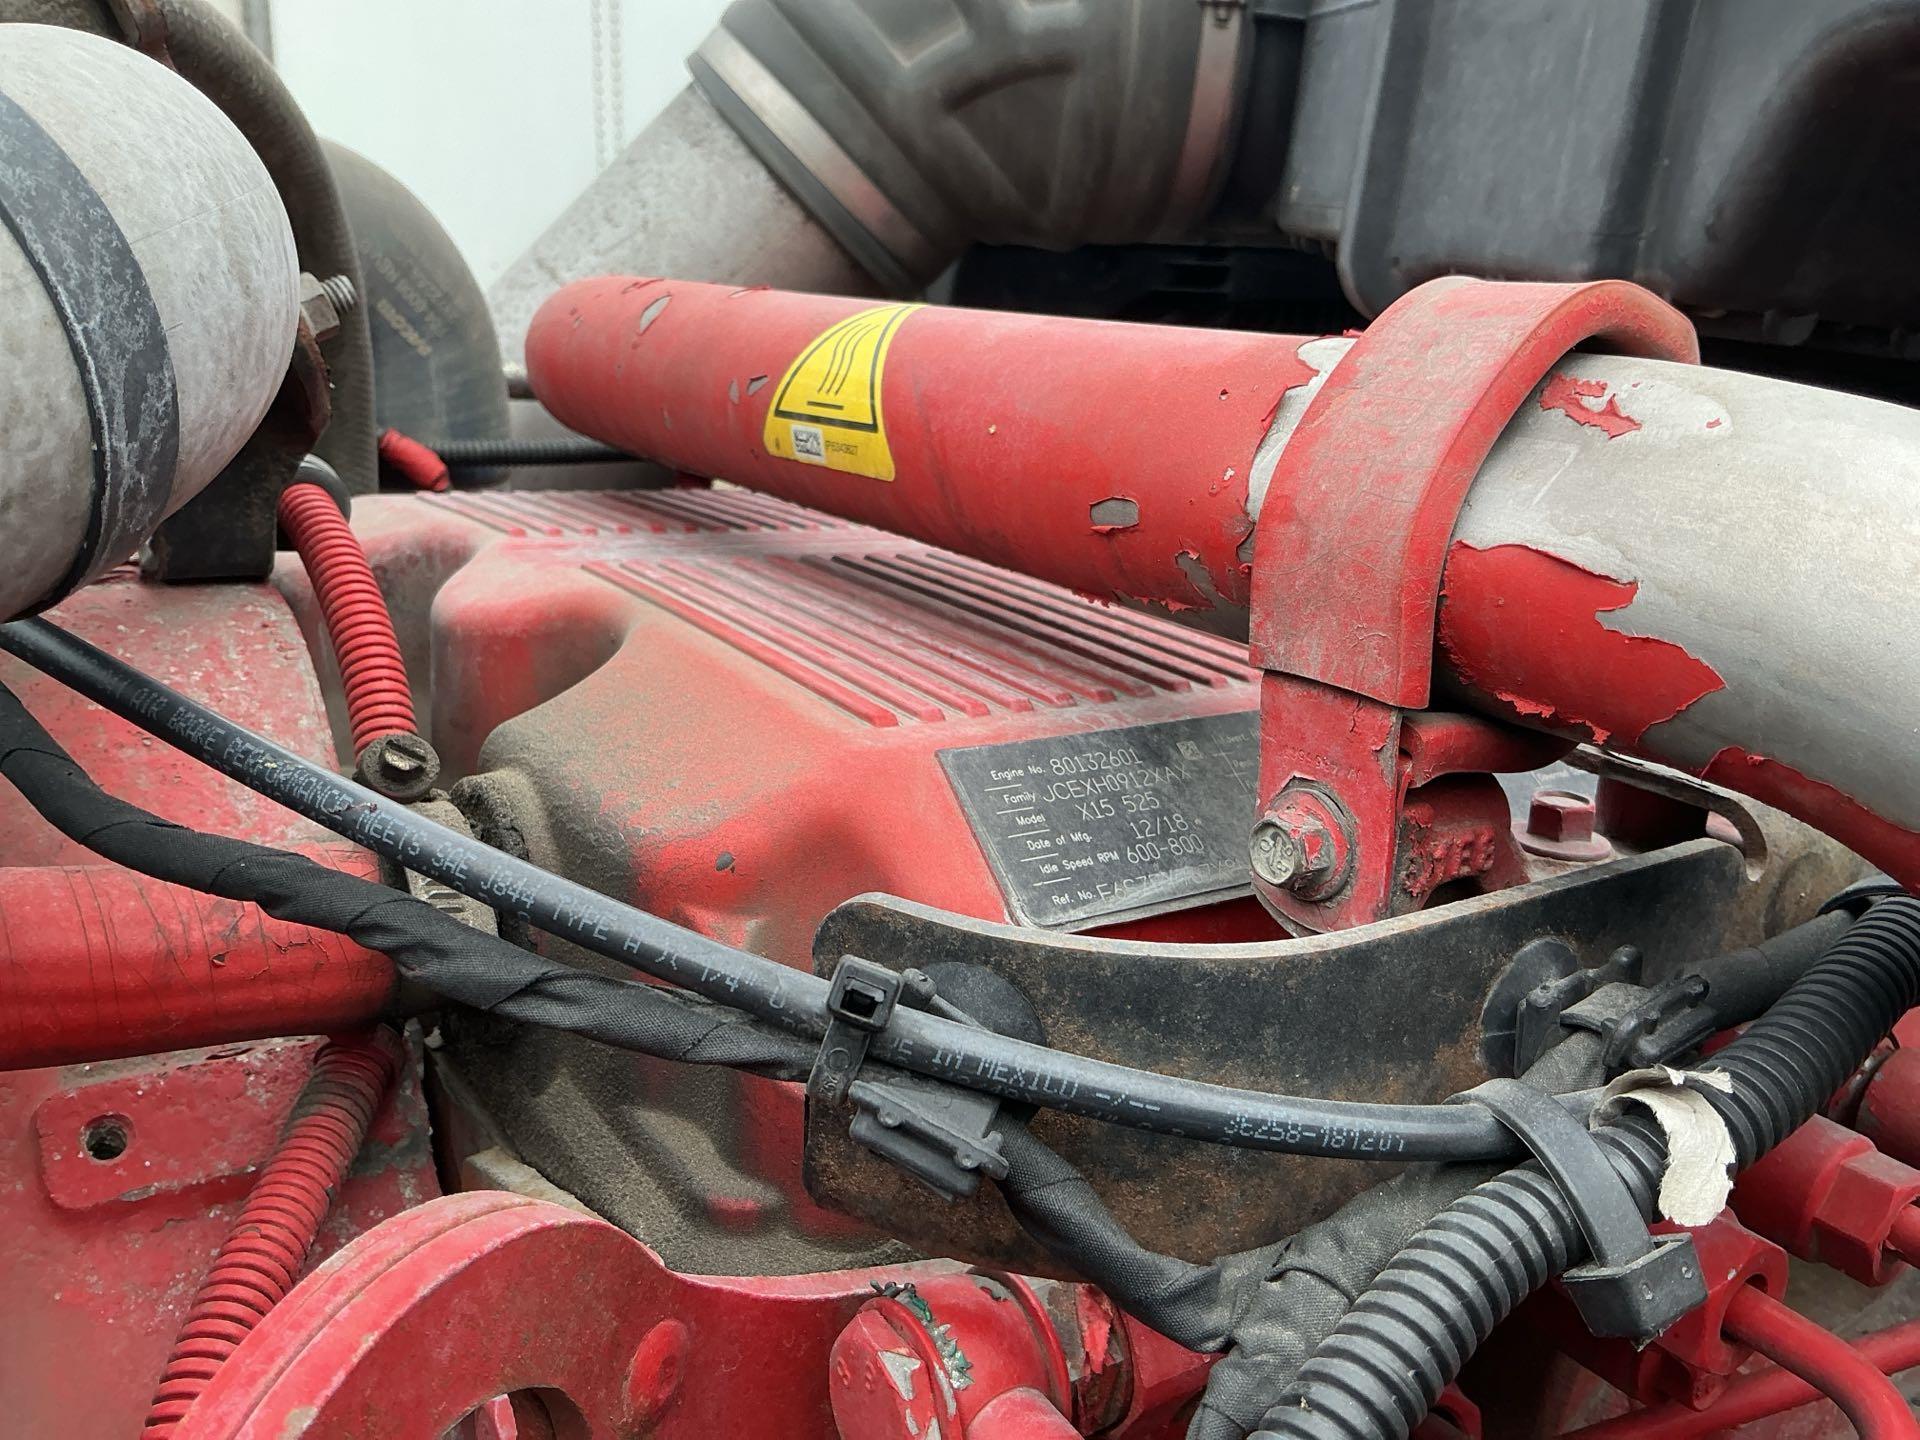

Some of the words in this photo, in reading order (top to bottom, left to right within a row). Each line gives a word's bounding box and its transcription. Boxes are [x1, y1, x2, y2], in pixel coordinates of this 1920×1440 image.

[990, 768, 1024, 781] Engine
[1028, 765, 1046, 775] No.
[1049, 748, 1143, 776] 80132601
[1003, 791, 1036, 804] Family
[1043, 762, 1192, 802] JCEXH0912XAX
[1015, 813, 1046, 826] Model
[1075, 798, 1115, 820] X15
[1122, 791, 1159, 813] 525
[1026, 838, 1051, 851] Date
[1056, 835, 1066, 845] of
[1070, 831, 1093, 843] Mfg.
[1130, 813, 1188, 839] 12/18
[1040, 863, 1059, 874] Idle
[1062, 856, 1093, 871] Speed
[1097, 851, 1119, 864] RPM
[1127, 833, 1204, 864] 600-800
[130, 687, 168, 720] AIR
[167, 705, 226, 751] BRAKE
[224, 736, 354, 820] PERFORMANCE
[356, 808, 427, 857] MEETS
[432, 841, 478, 880] SAE
[481, 864, 542, 909] J844
[553, 893, 618, 942] TYPE
[932, 1047, 965, 1070] IN
[976, 1055, 1080, 1099] MEXICO
[1051, 893, 1074, 906] Ref.
[1077, 890, 1096, 901] No.
